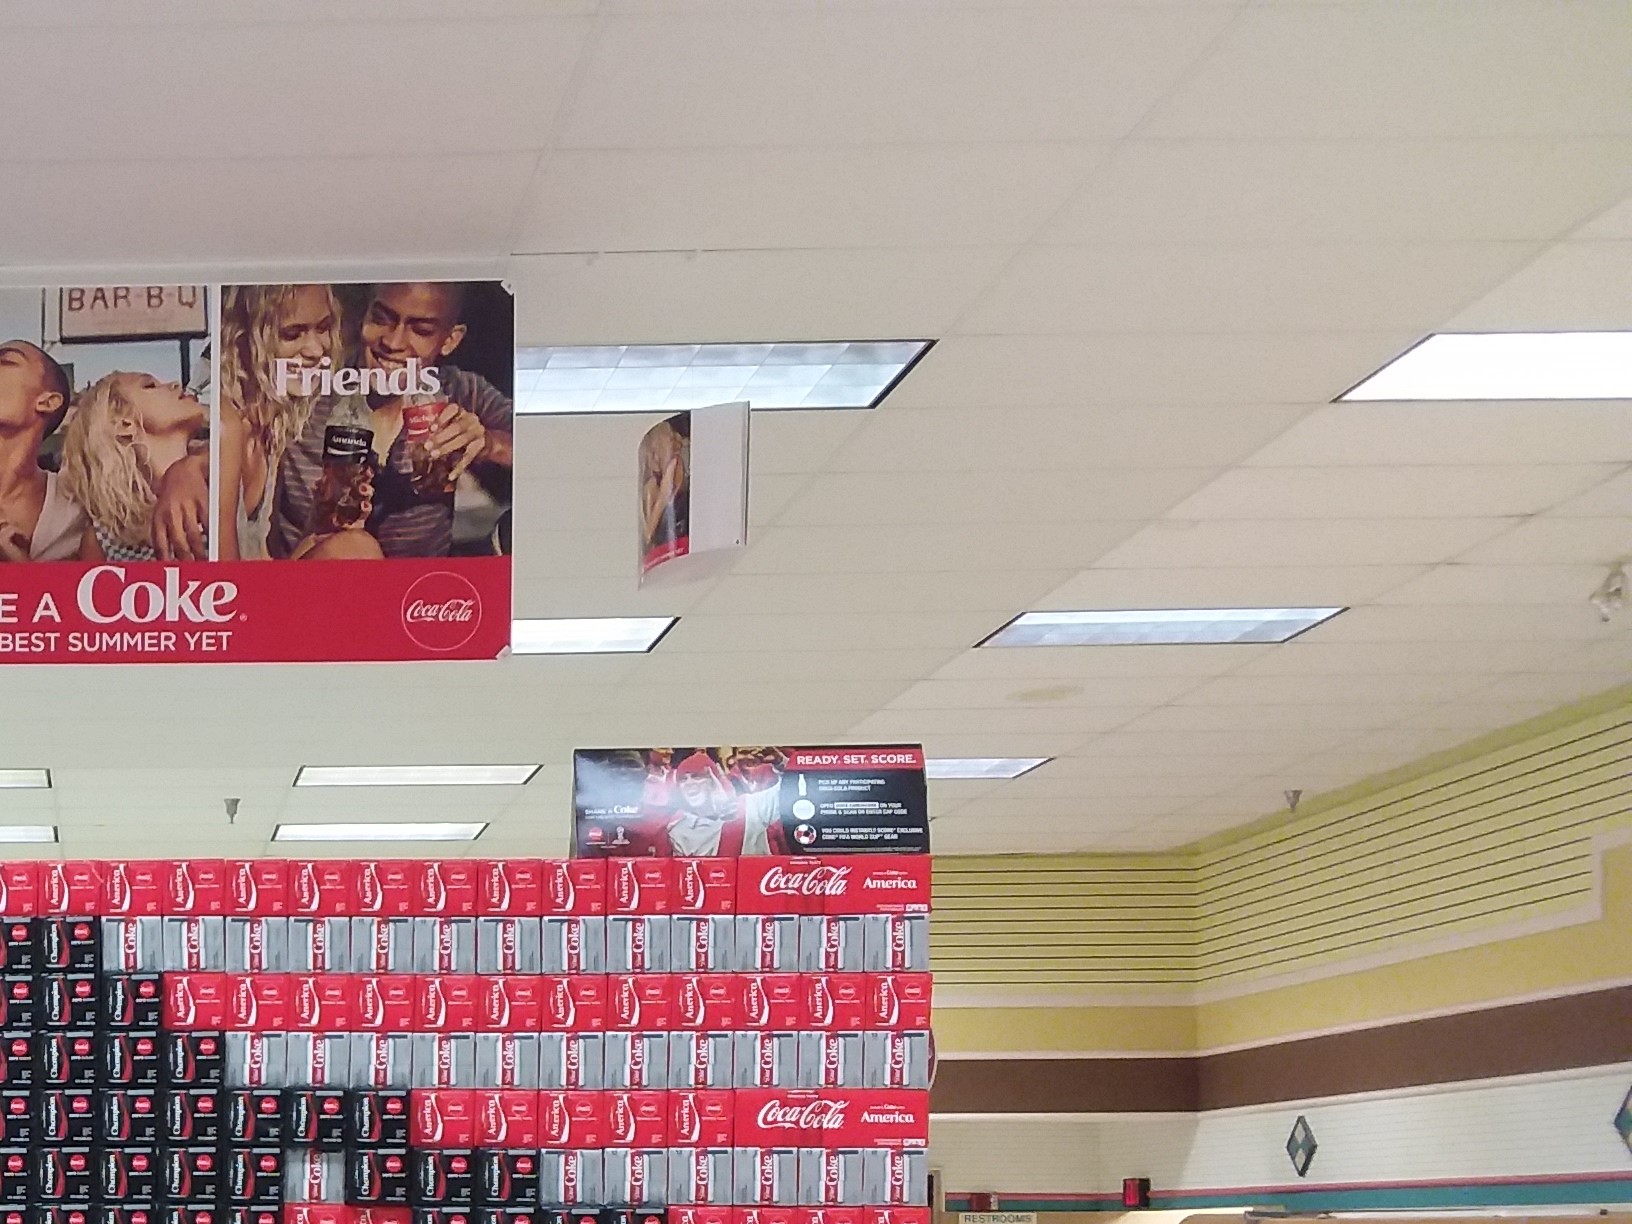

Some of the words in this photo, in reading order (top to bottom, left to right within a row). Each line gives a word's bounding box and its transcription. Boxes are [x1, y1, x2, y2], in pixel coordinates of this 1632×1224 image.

[274, 357, 441, 396] Friends
[32, 594, 61, 623] A
[77, 565, 239, 624] Coke
[406, 599, 474, 622] Coca-Cola
[68, 632, 176, 651] SUMMER
[183, 632, 232, 651] YET
[796, 754, 841, 765] READY.
[843, 754, 868, 764] SET.
[871, 754, 916, 764] SCORE.
[759, 866, 852, 896] Coca-Cola
[863, 876, 917, 890] America
[757, 1100, 849, 1130] Coca-Cola
[861, 1110, 915, 1123] America
[964, 1214, 1033, 1224] RESTROOMS
